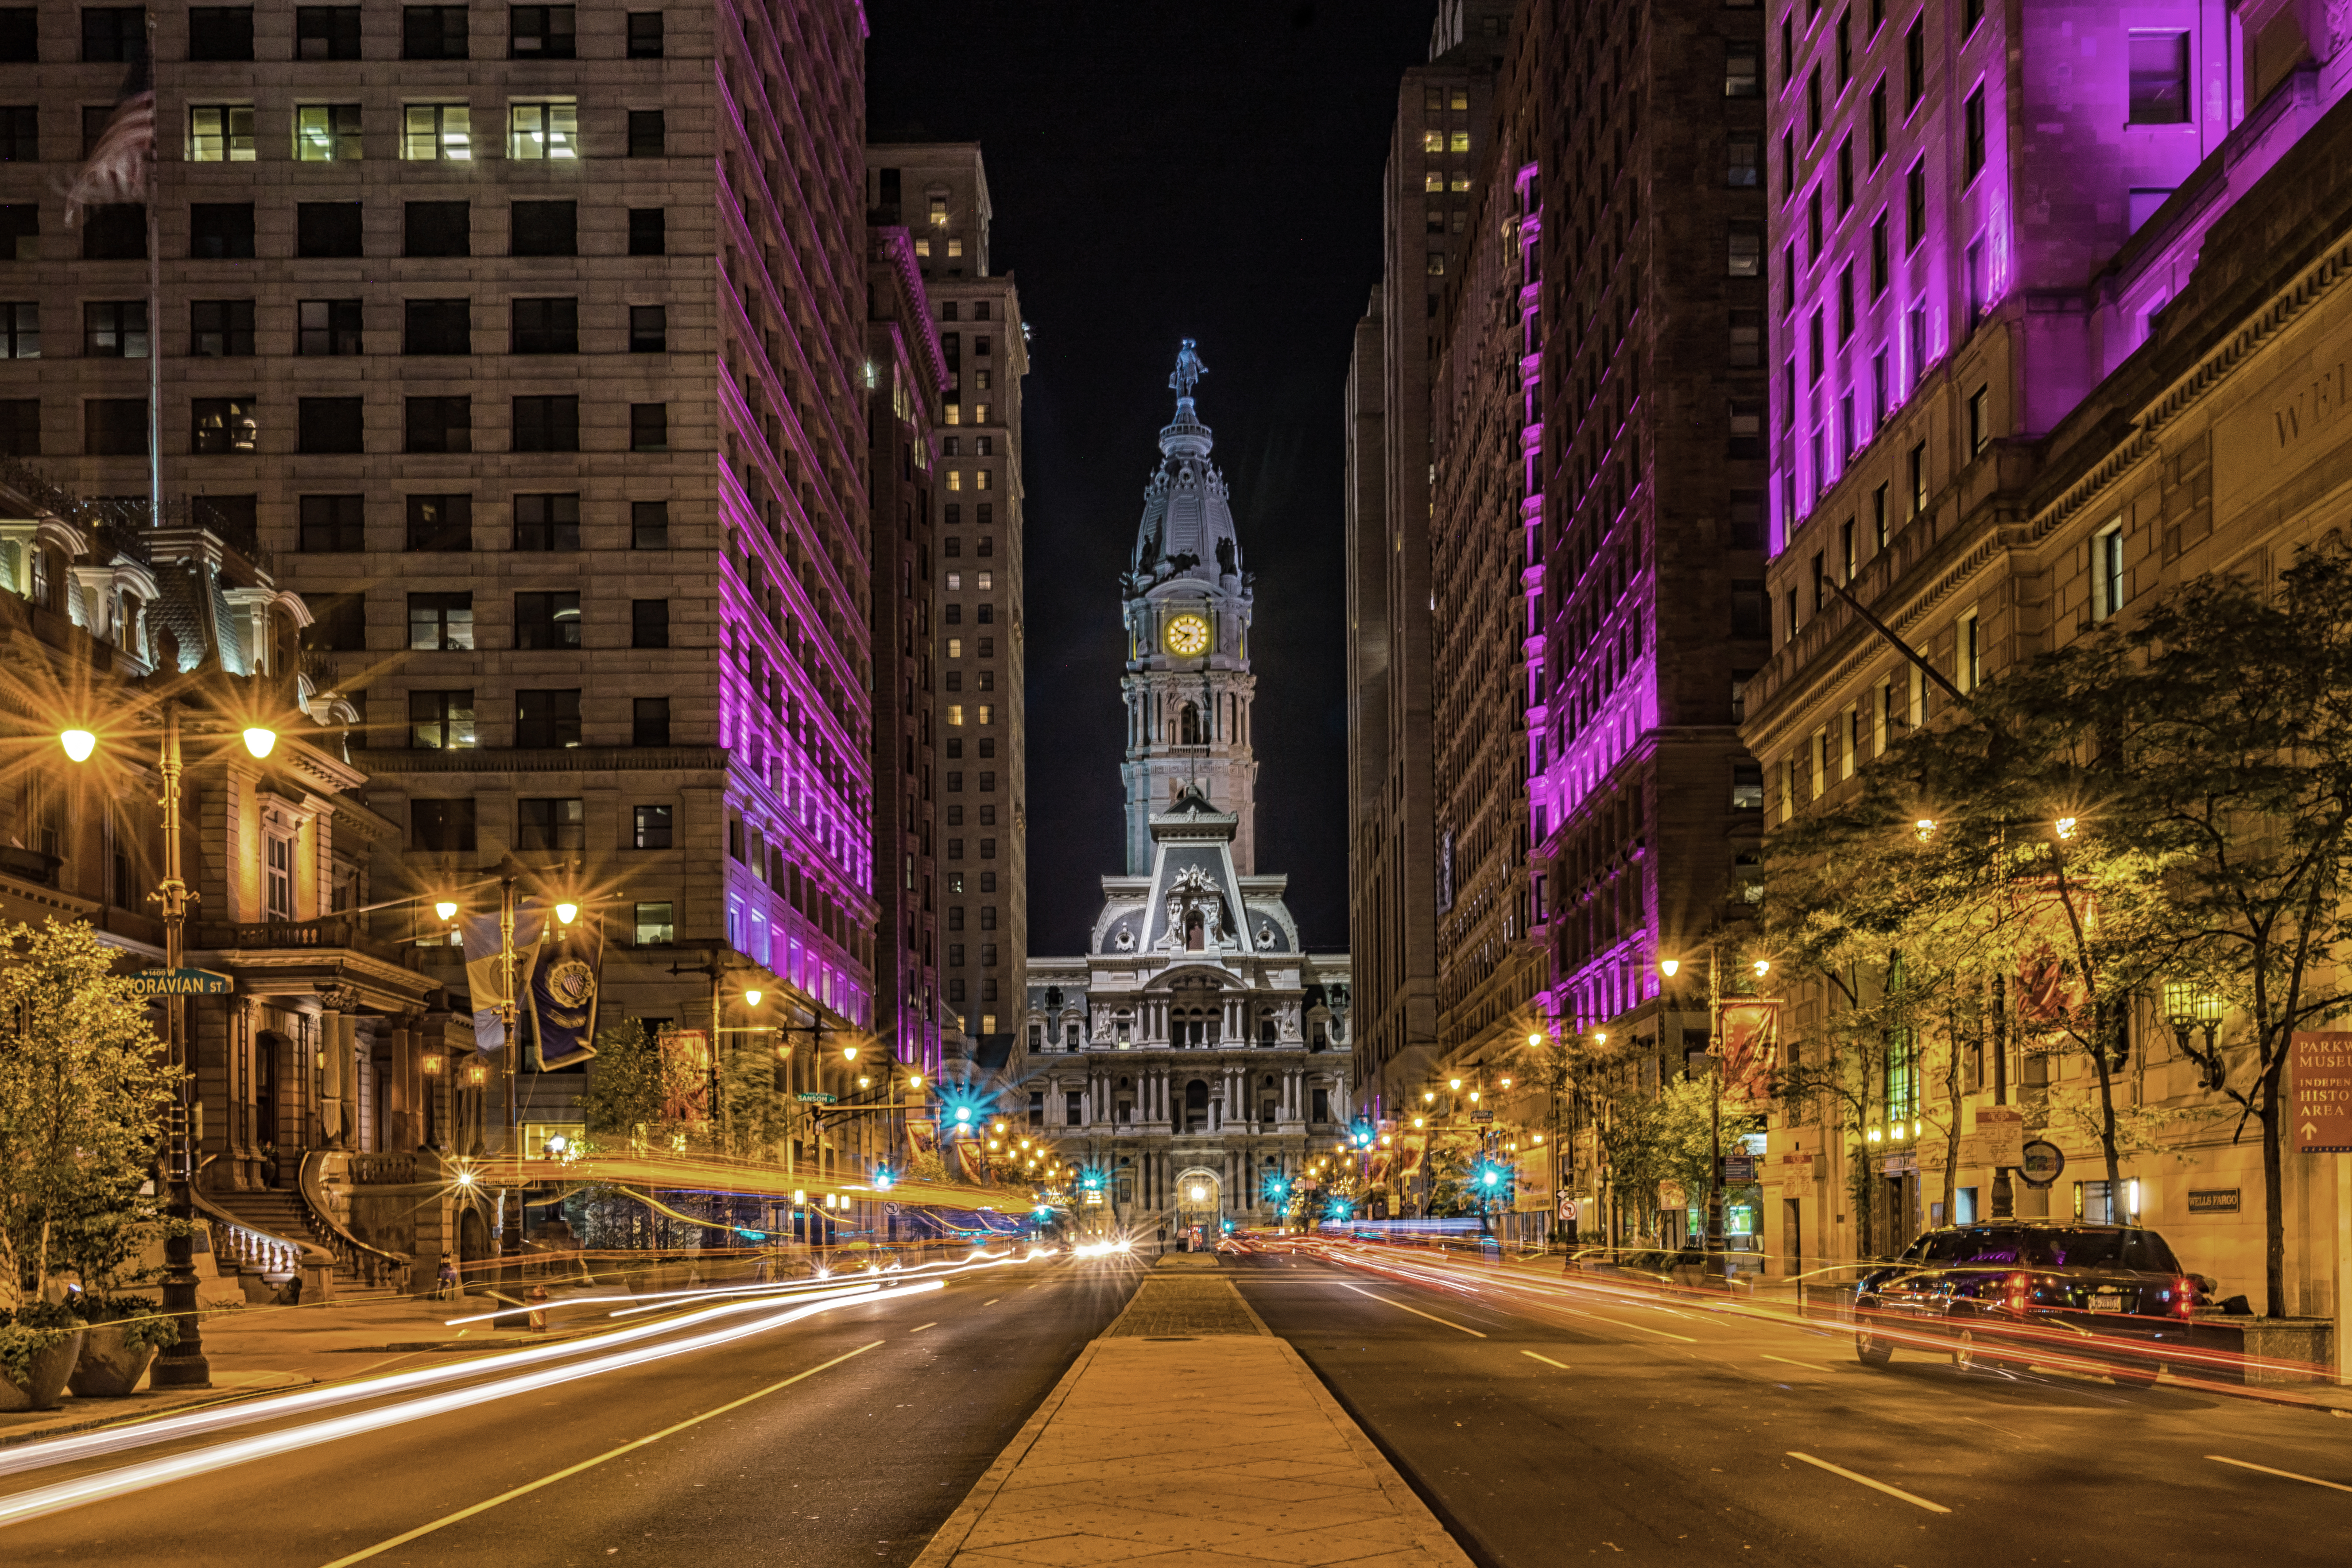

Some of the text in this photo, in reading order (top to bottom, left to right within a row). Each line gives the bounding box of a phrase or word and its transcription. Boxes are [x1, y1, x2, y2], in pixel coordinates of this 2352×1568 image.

[134, 977, 222, 994] ORAVIAN ST
[2300, 1078, 2350, 1087] INDEPEN
[2300, 1090, 2349, 1101] HISTO
[2300, 1105, 2344, 1116] AREA
[2189, 1195, 2236, 1206] WELLS FARGO
